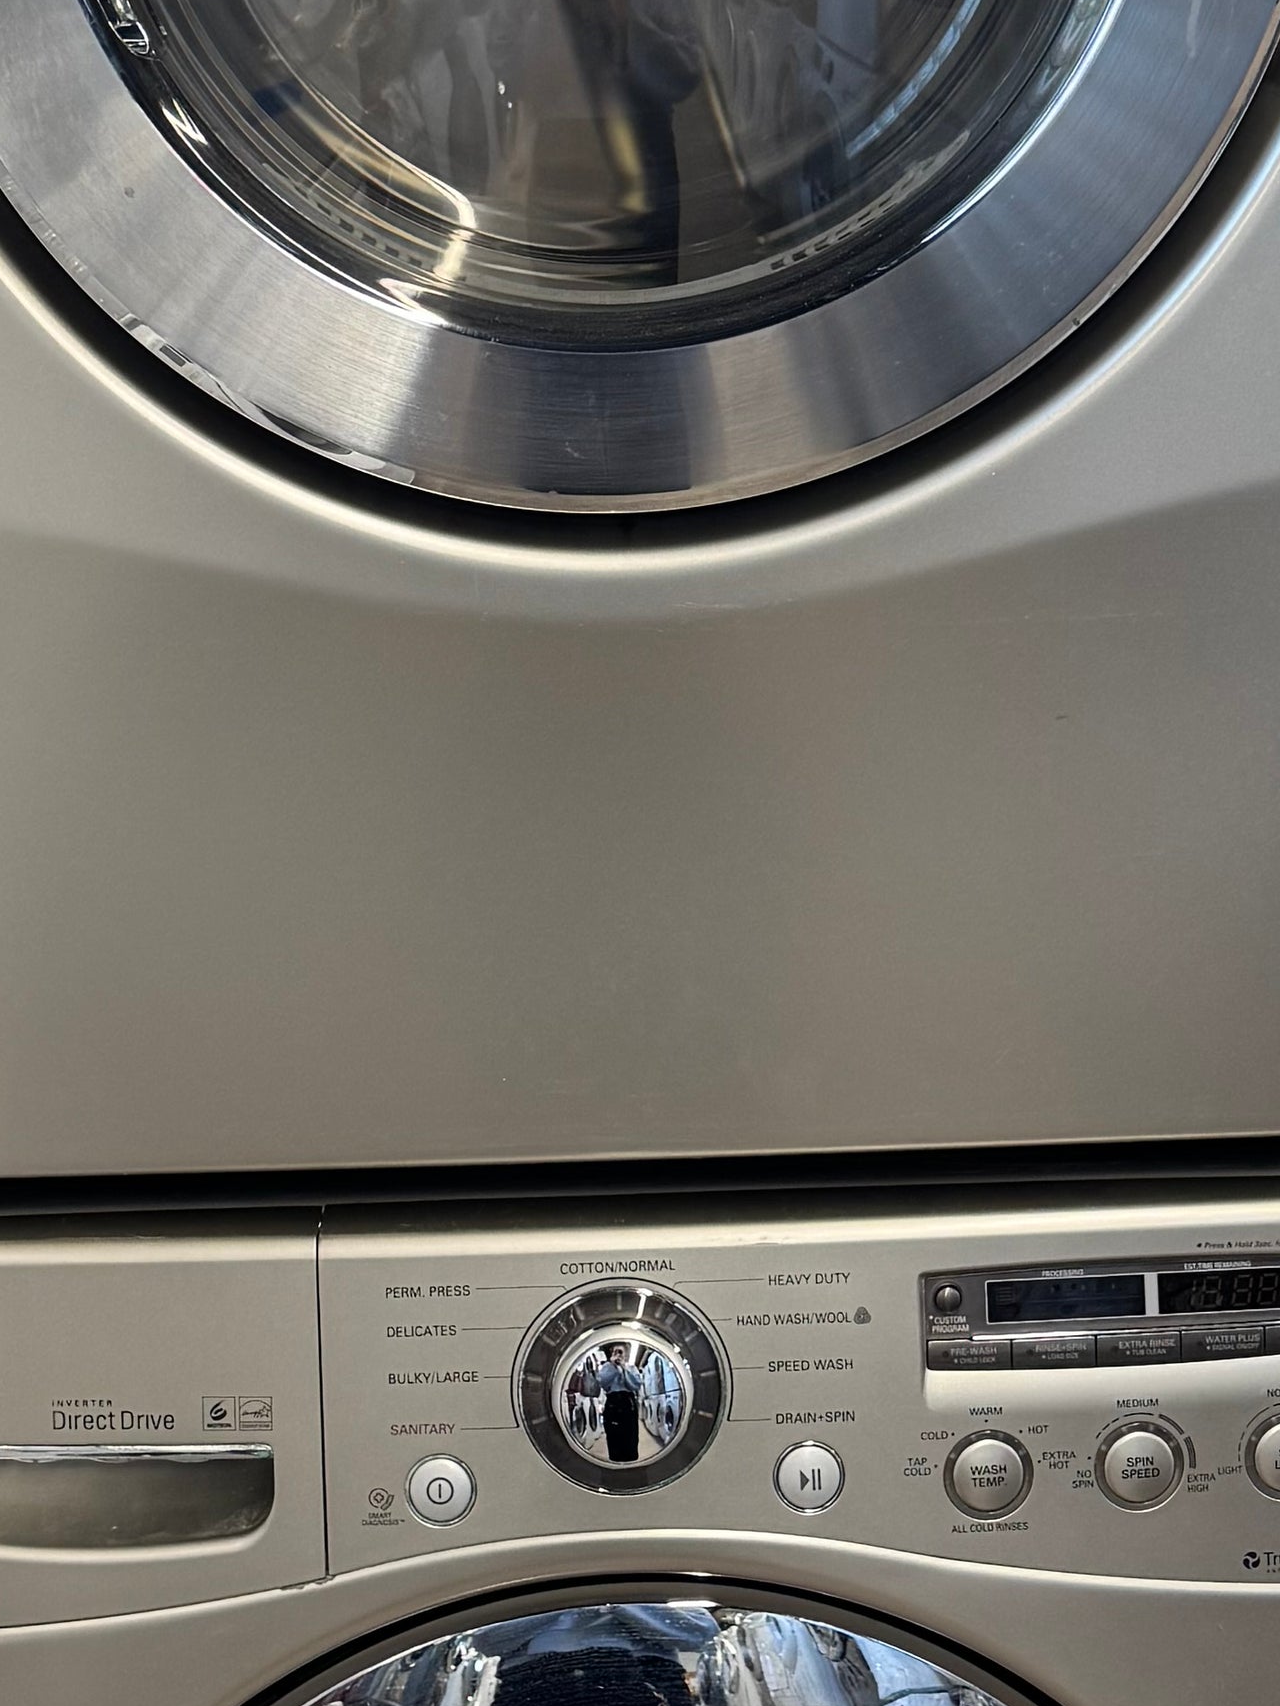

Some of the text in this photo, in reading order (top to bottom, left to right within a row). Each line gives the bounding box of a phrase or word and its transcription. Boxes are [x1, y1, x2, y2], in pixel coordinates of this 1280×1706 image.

[560, 1260, 675, 1274] COTTON/NORMAL
[769, 1272, 850, 1286] HEAVY DUTY
[386, 1285, 470, 1298] PERM. PRESS
[737, 1311, 851, 1326] HAND WASH/WOOL
[387, 1325, 456, 1337] DELICATES
[769, 1359, 853, 1372] SPEED WASH
[388, 1371, 478, 1384] BULKY/LARGE
[1117, 1398, 1158, 1409] MEDIUM
[970, 1406, 1003, 1416] WARM
[52, 1410, 175, 1431] Direct Drive
[775, 1410, 855, 1424] DRAIN+SPIN
[390, 1424, 455, 1436] SANITARY
[1029, 1425, 1048, 1435] HOT
[921, 1431, 948, 1441] COLD
[1043, 1450, 1076, 1461] EXTRA
[908, 1458, 927, 1467] TAP
[1049, 1460, 1069, 1470] HOT
[1127, 1457, 1154, 1468] SPIN
[904, 1467, 931, 1477] COLD
[971, 1464, 1006, 1477] WASH
[1077, 1470, 1092, 1480] NO
[1122, 1468, 1160, 1480] SPEED
[1218, 1466, 1242, 1476] LIGHT
[972, 1477, 1006, 1488] TEMP.
[1188, 1473, 1215, 1483] EXTRA
[1072, 1480, 1093, 1489] SPIN
[1188, 1483, 1209, 1493] HIGH
